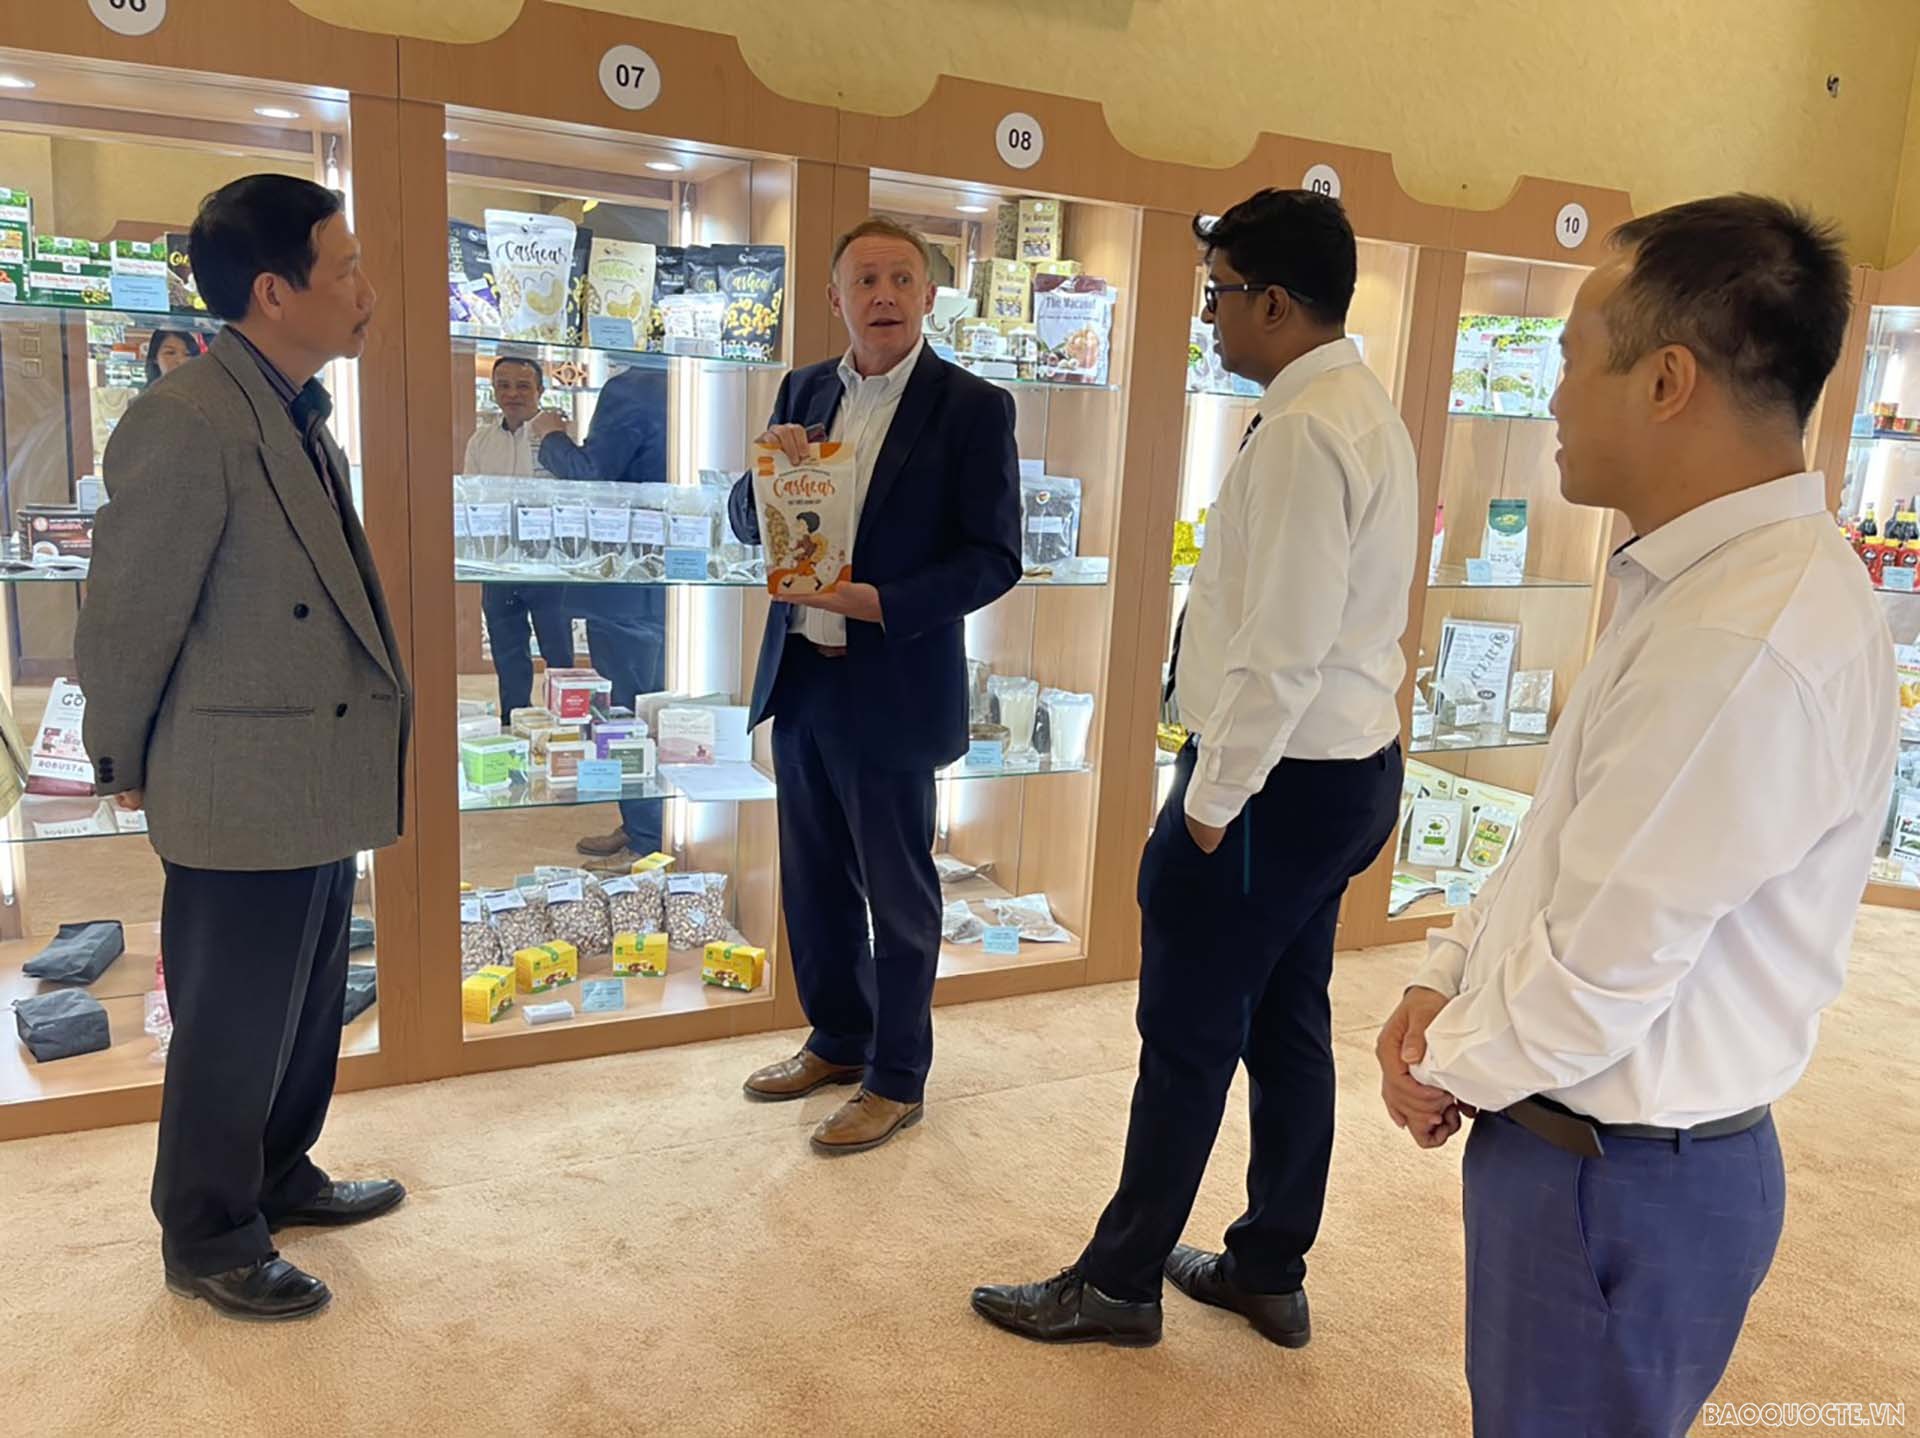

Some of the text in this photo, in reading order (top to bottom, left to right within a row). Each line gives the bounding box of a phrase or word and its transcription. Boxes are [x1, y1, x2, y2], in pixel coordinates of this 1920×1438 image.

[615, 63, 645, 89] 07
[1008, 128, 1032, 152] 08
[1312, 178, 1331, 197] 09
[1564, 216, 1580, 234] 10
[773, 474, 835, 499] Cashews
[38, 760, 85, 773] ROBUSTA
